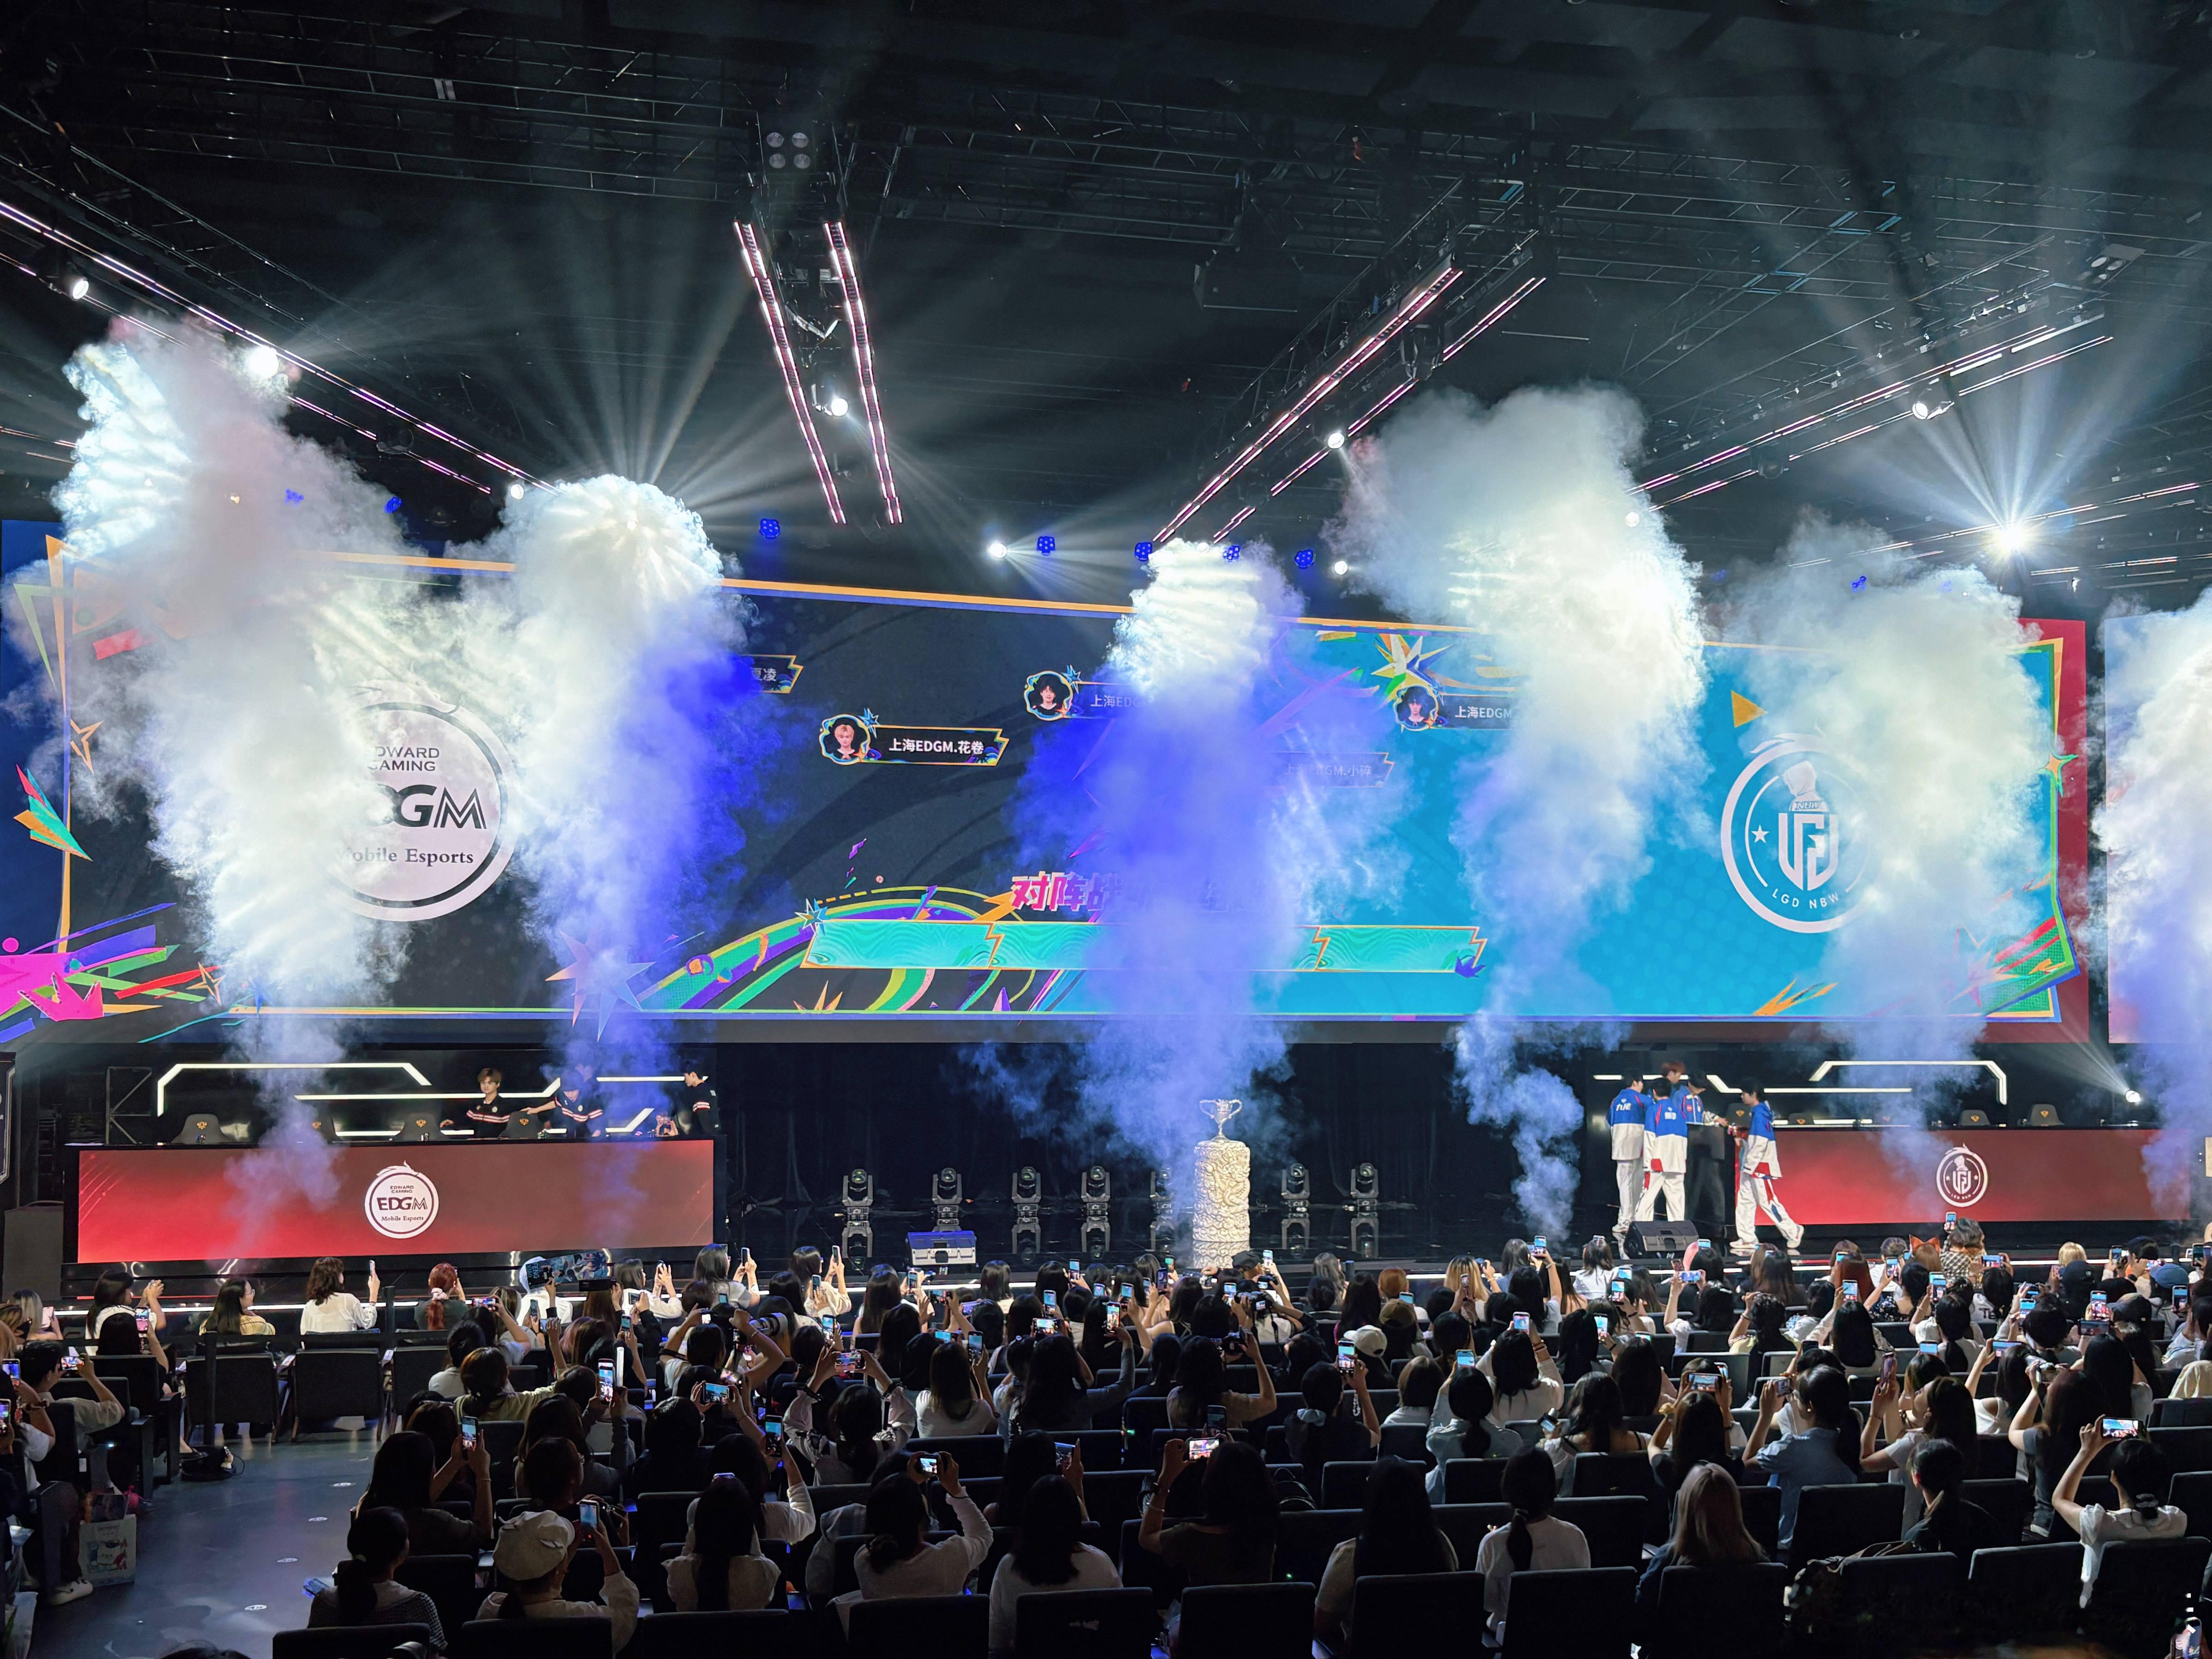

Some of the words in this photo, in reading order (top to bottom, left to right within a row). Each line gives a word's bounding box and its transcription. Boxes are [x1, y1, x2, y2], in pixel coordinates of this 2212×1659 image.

[375, 746, 440, 758] DWARD
[889, 739, 984, 755] 上海EDGM.花卷
[405, 848, 474, 866] Esports
[1771, 888, 1800, 908] LGD
[1809, 892, 1839, 909] NBW
[377, 1197, 428, 1211] EDGM
